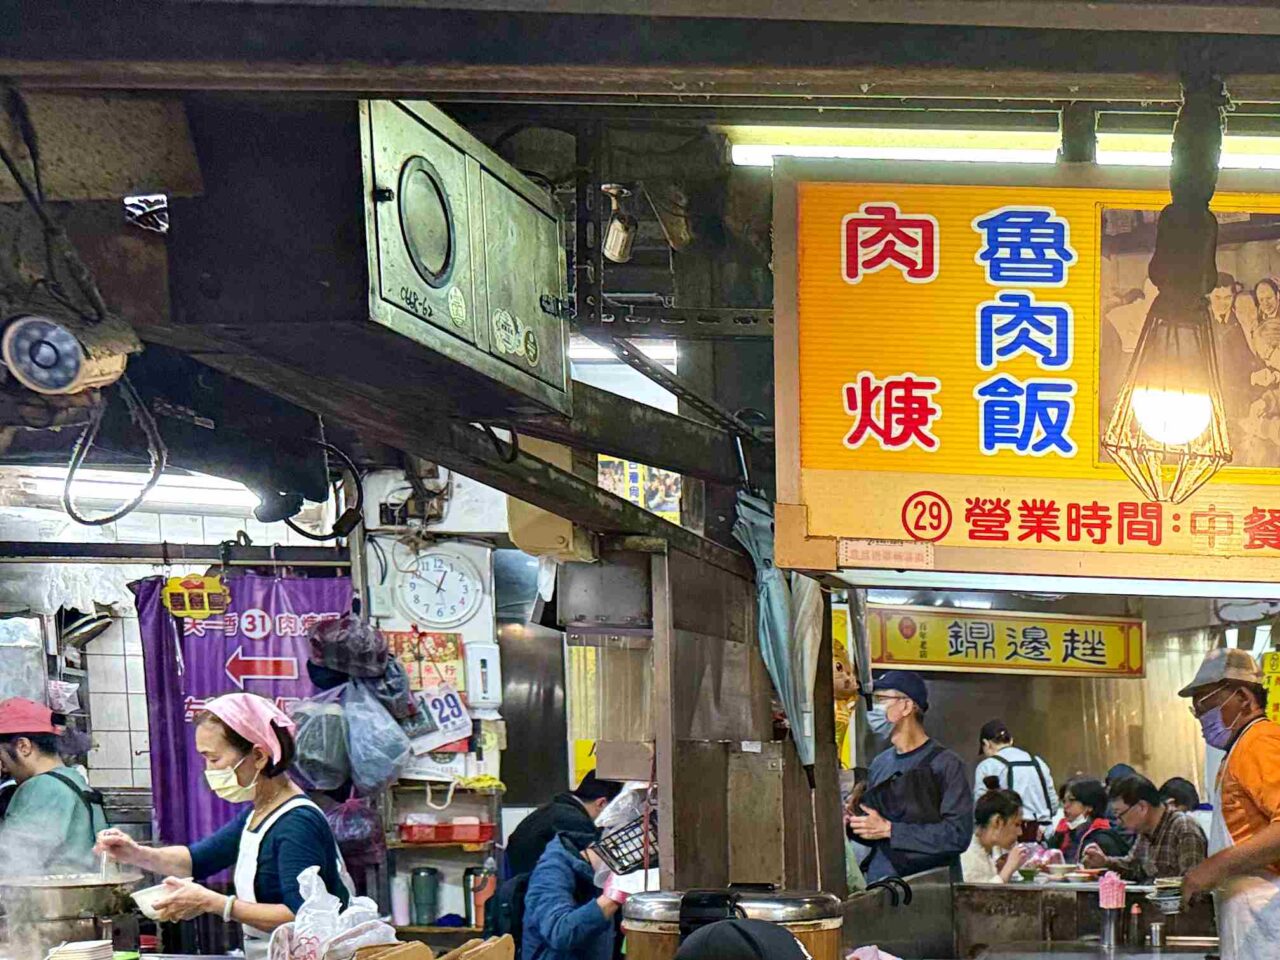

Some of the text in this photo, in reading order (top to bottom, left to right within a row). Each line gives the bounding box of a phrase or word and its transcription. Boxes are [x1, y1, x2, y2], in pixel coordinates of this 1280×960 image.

[976, 208, 1076, 455] 魯肉飯
[908, 496, 947, 536] 29
[421, 561, 429, 571] 11
[433, 558, 444, 569] 12
[450, 563, 454, 572] 1
[459, 572, 465, 582] 2
[409, 582, 416, 591] 9
[463, 584, 469, 594] 3
[413, 594, 420, 604] 8
[459, 597, 465, 606] 4
[423, 603, 430, 613] 7
[437, 608, 443, 617] 6
[450, 605, 456, 615] 5
[431, 692, 463, 724] 29
